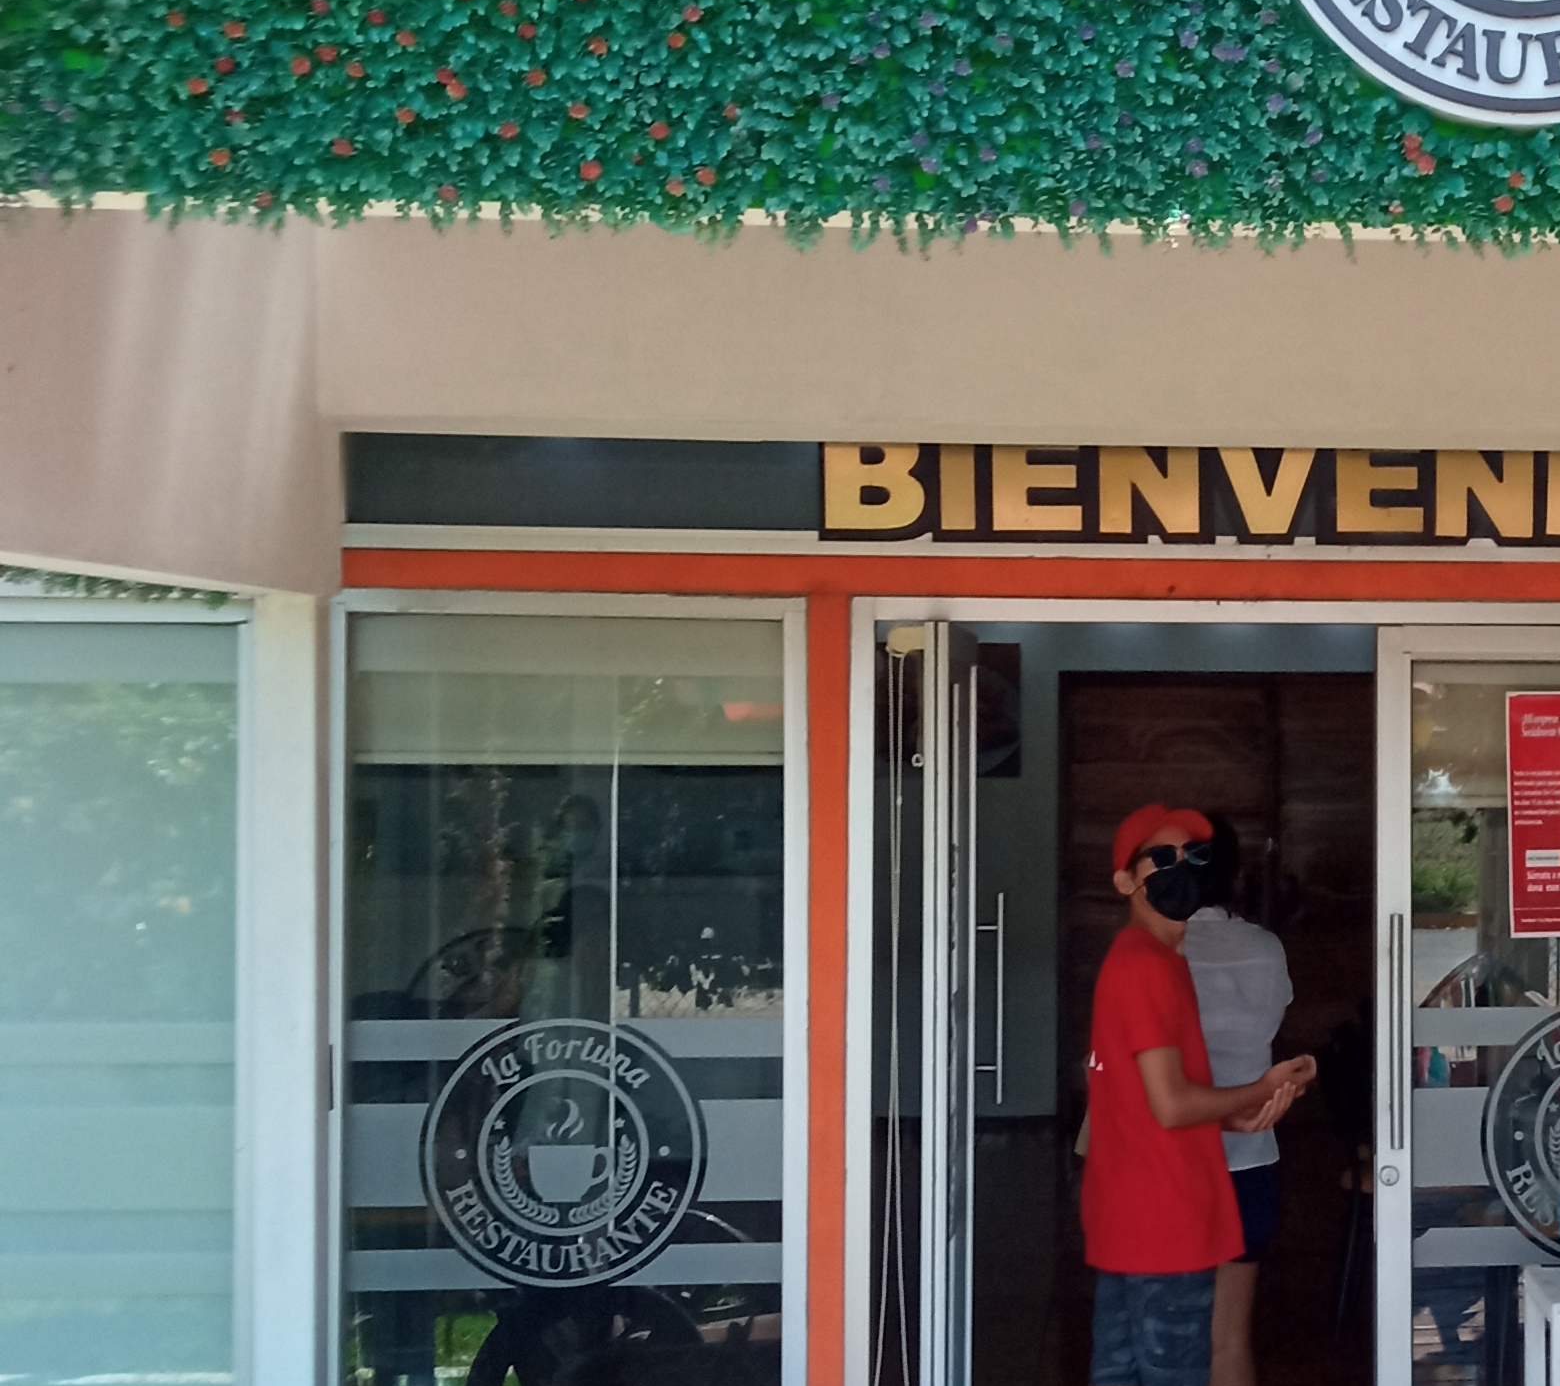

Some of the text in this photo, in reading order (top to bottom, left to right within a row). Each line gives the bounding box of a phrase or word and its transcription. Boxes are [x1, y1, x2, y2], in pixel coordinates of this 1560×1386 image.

[480, 1031, 651, 1090] La Fortuna
[445, 1178, 679, 1274] RESTAURANTE
